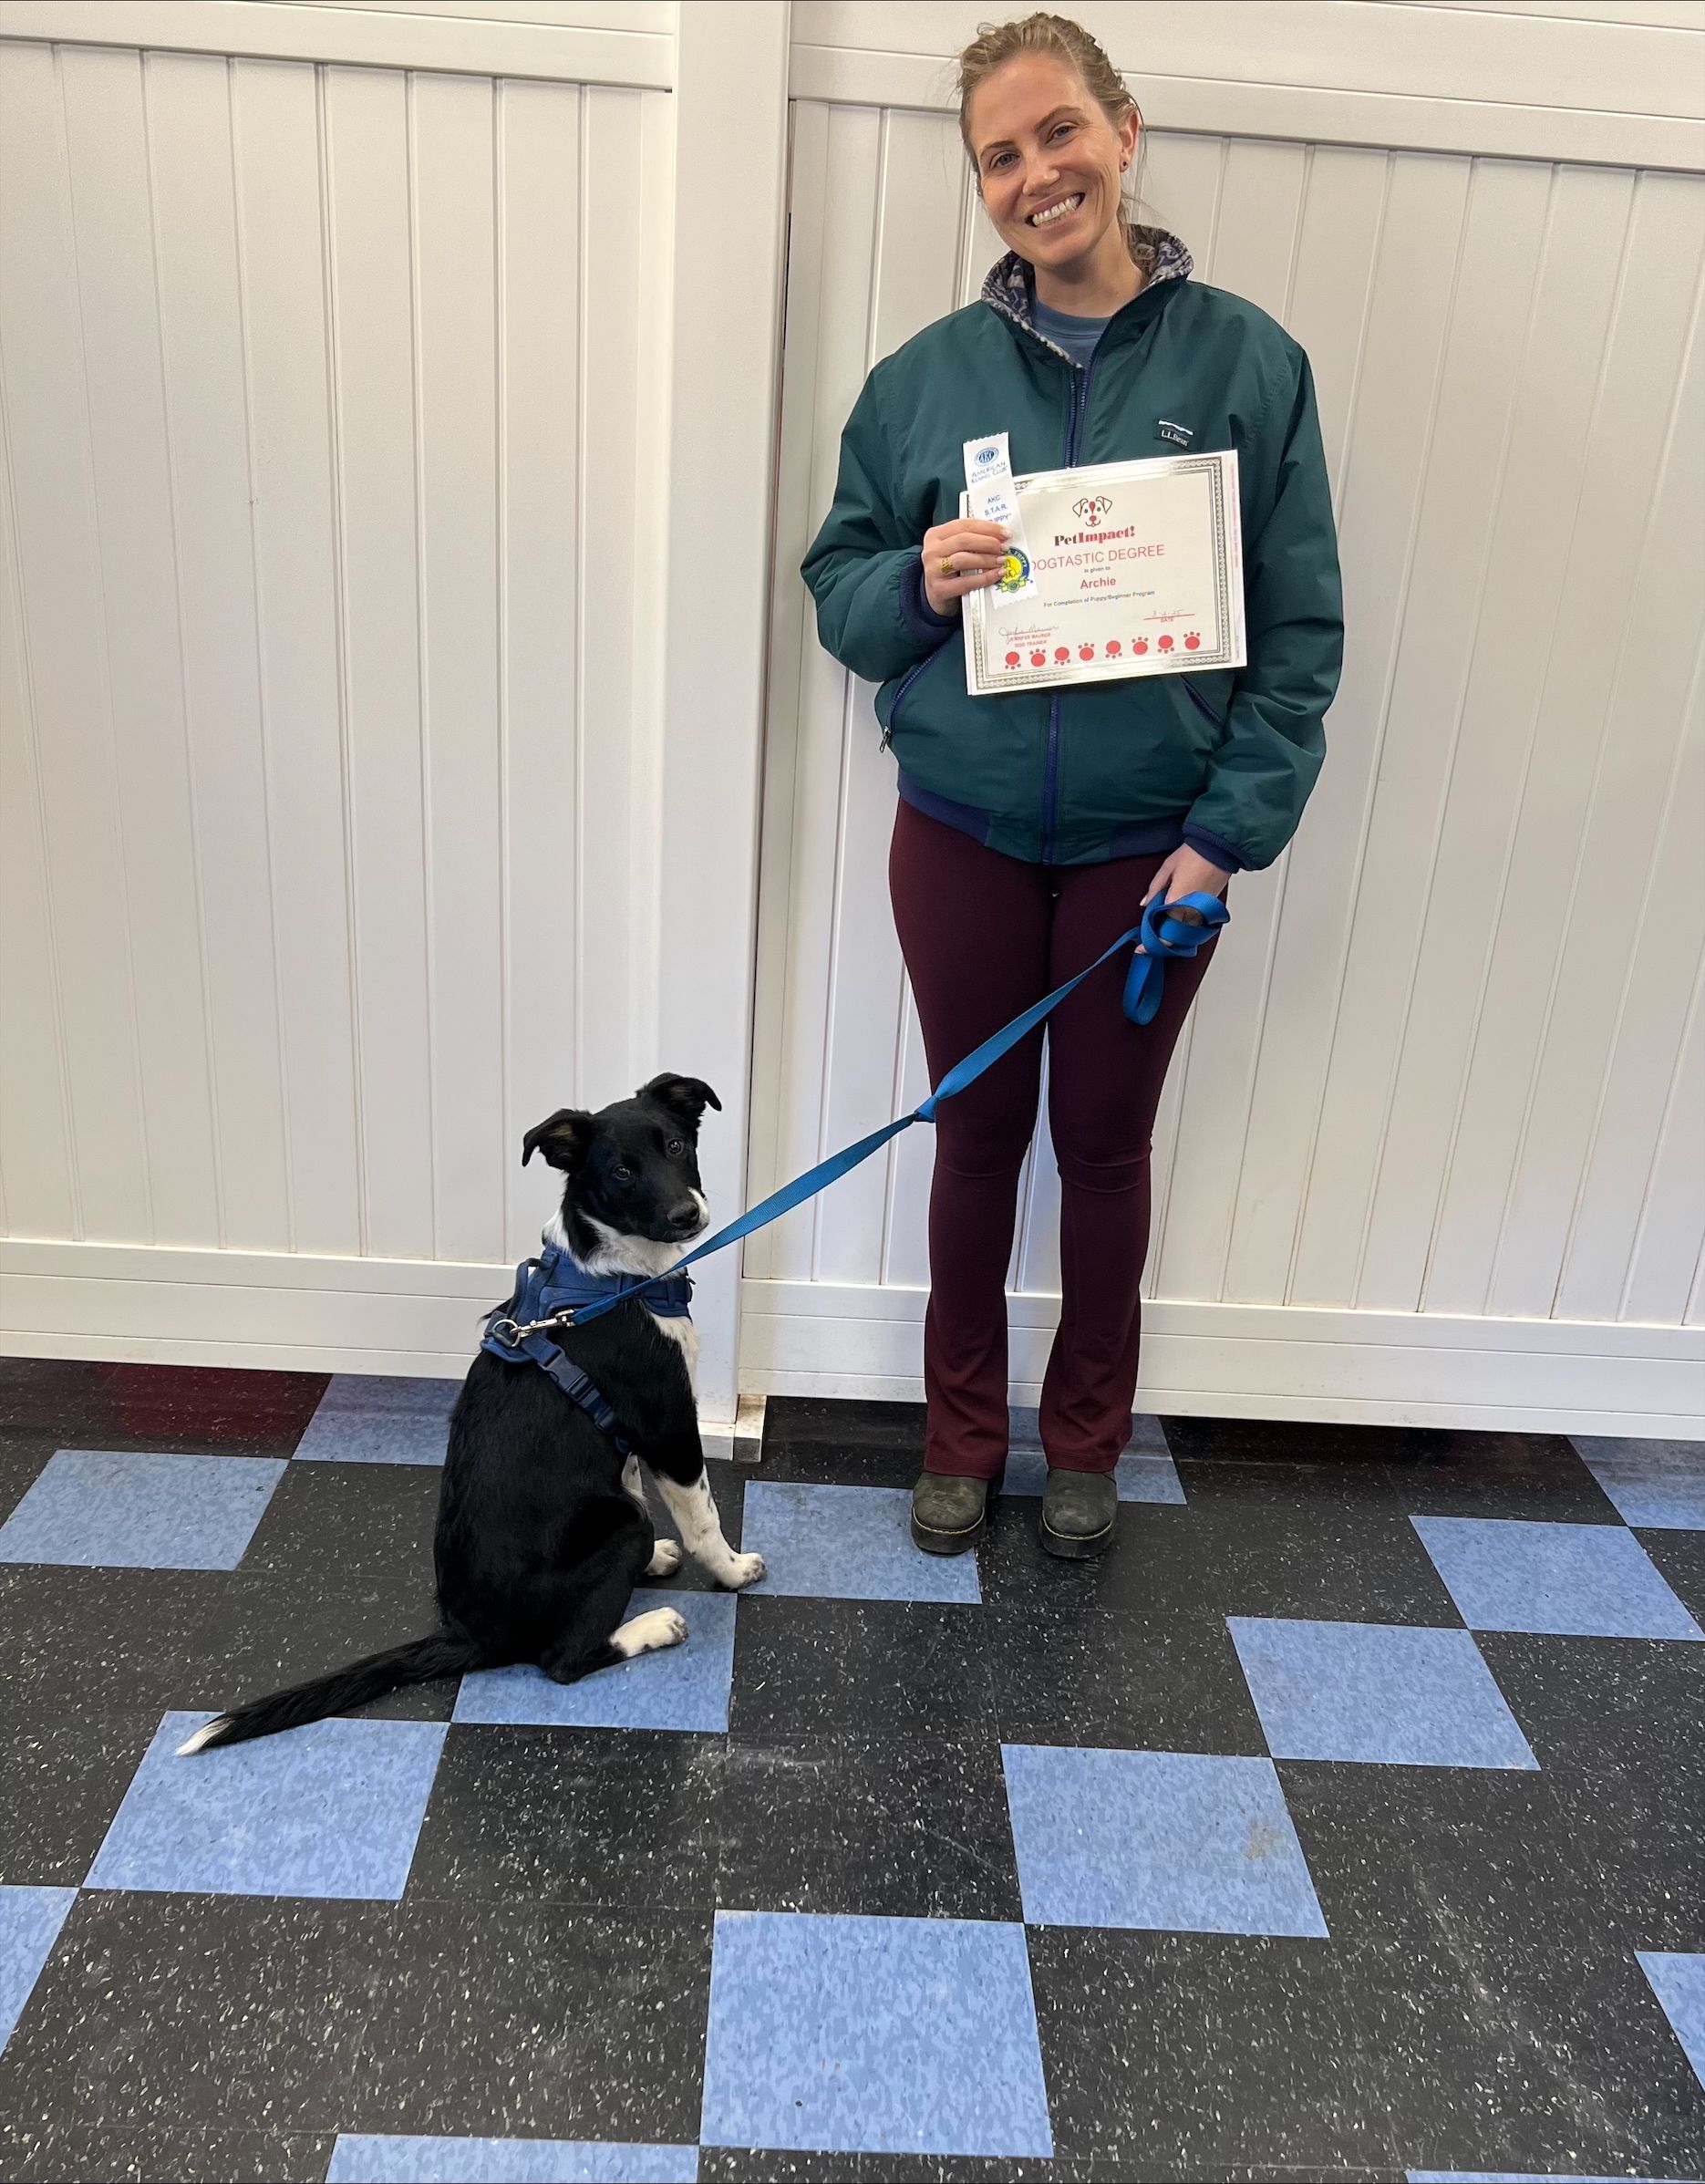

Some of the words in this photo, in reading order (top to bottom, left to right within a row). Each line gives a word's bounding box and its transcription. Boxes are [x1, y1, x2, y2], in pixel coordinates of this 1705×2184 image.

[987, 494, 1001, 503] AKC
[1054, 525, 1135, 546] PetImpact!
[1108, 544, 1165, 561] DEGREE
[1090, 566, 1104, 574] given
[1080, 576, 1117, 590] Archie
